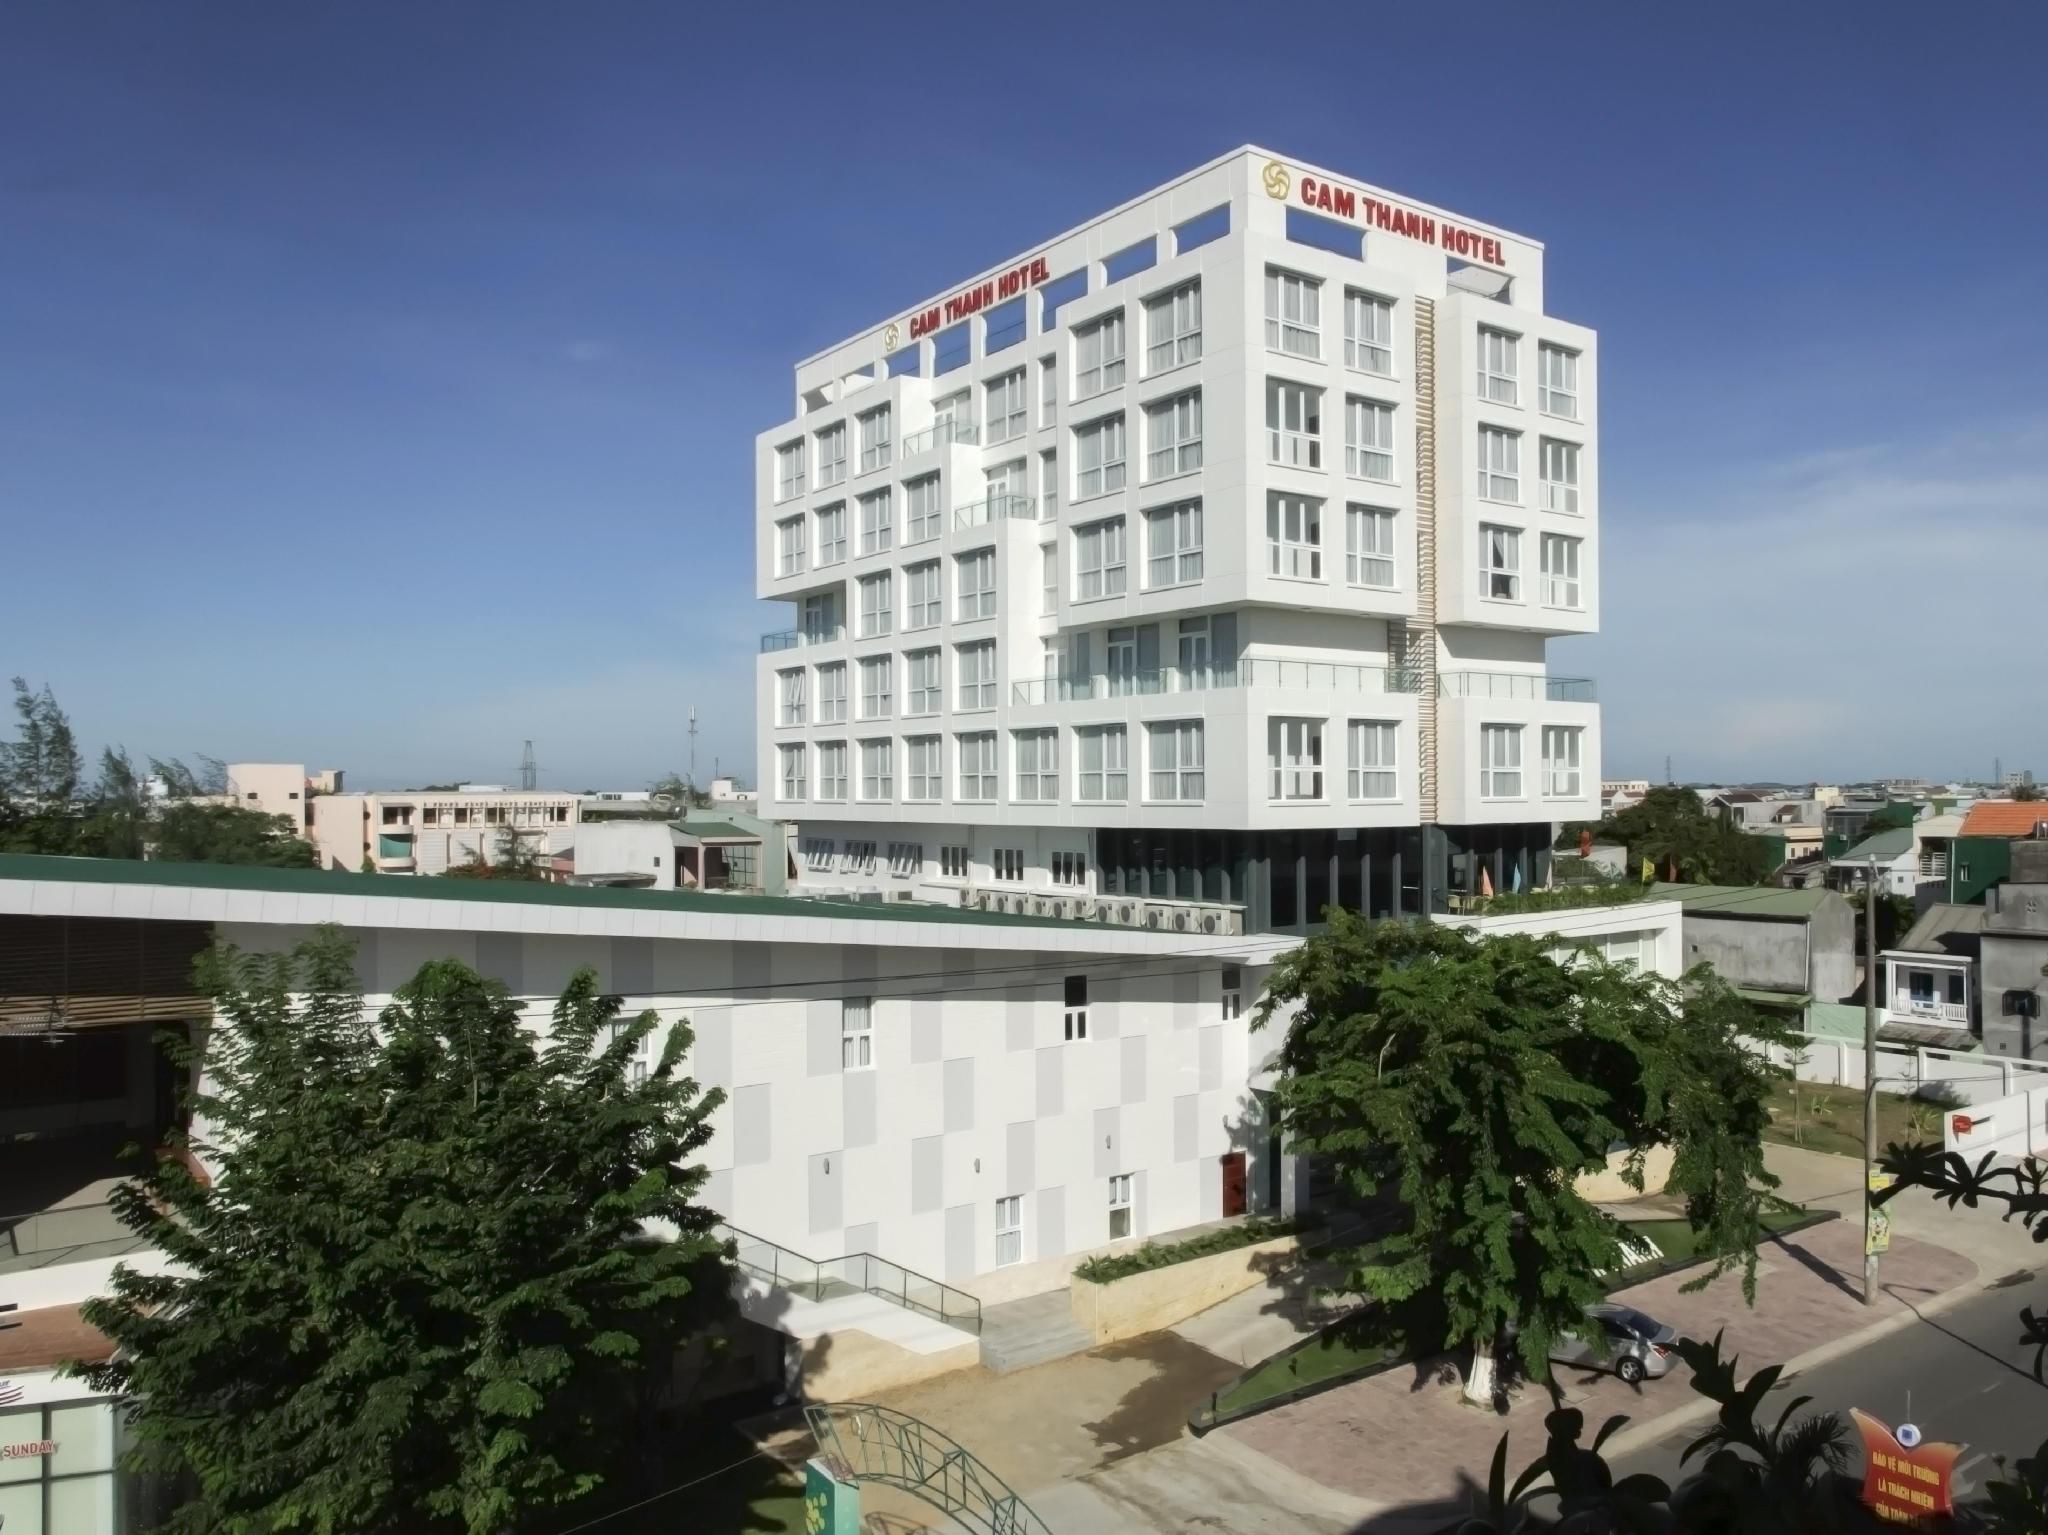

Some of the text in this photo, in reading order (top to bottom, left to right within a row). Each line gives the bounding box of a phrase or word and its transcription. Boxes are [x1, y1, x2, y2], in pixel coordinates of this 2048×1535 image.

[1301, 177, 1506, 267] CAM THANH HOTEL
[910, 256, 1050, 340] CAM THANH HOTEL
[3, 1440, 54, 1457] SUNDAY
